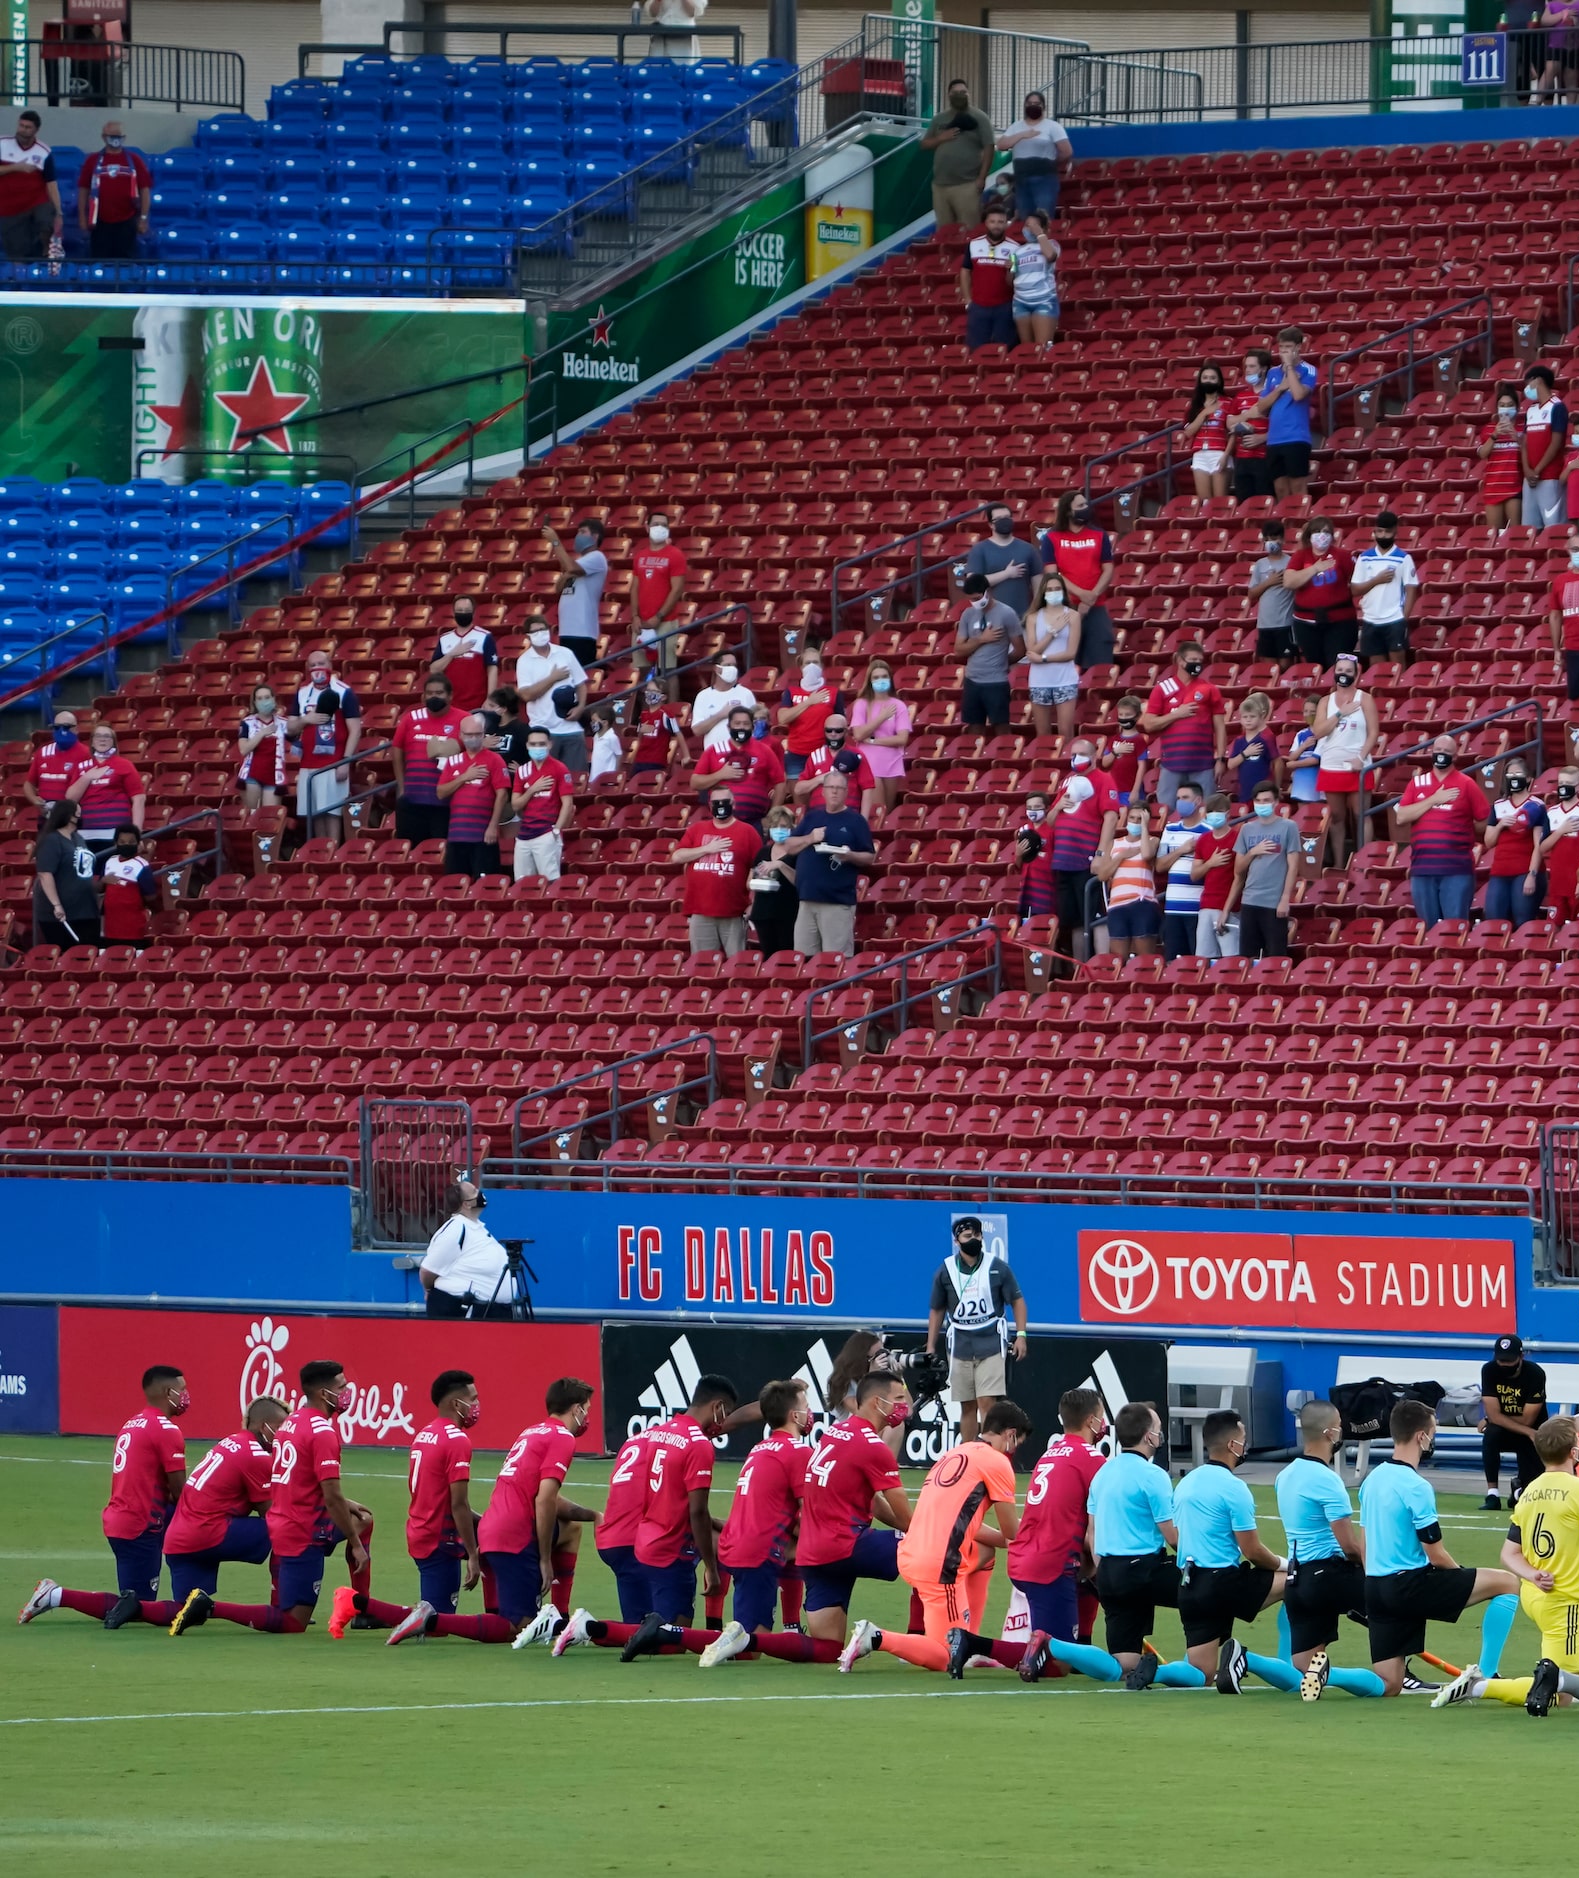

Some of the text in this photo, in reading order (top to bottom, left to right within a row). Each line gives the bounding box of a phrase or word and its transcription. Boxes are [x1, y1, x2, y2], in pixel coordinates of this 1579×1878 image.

[1467, 48, 1501, 80] 111
[735, 230, 775, 260] SOCCER
[820, 224, 859, 242] Heineken
[735, 258, 748, 286] IS
[751, 261, 784, 288] HERE
[562, 351, 638, 382] Heineken
[617, 1225, 835, 1307] FC DALLAS
[1165, 1256, 1507, 1309] TOYOTA STADIUM
[112, 1433, 131, 1473] 8
[186, 1449, 224, 1491] 21
[410, 1449, 422, 1493] 7
[610, 1445, 640, 1484] 2
[650, 1447, 667, 1493] 5
[1027, 1463, 1055, 1505] 3
[1532, 1512, 1555, 1560] 6
